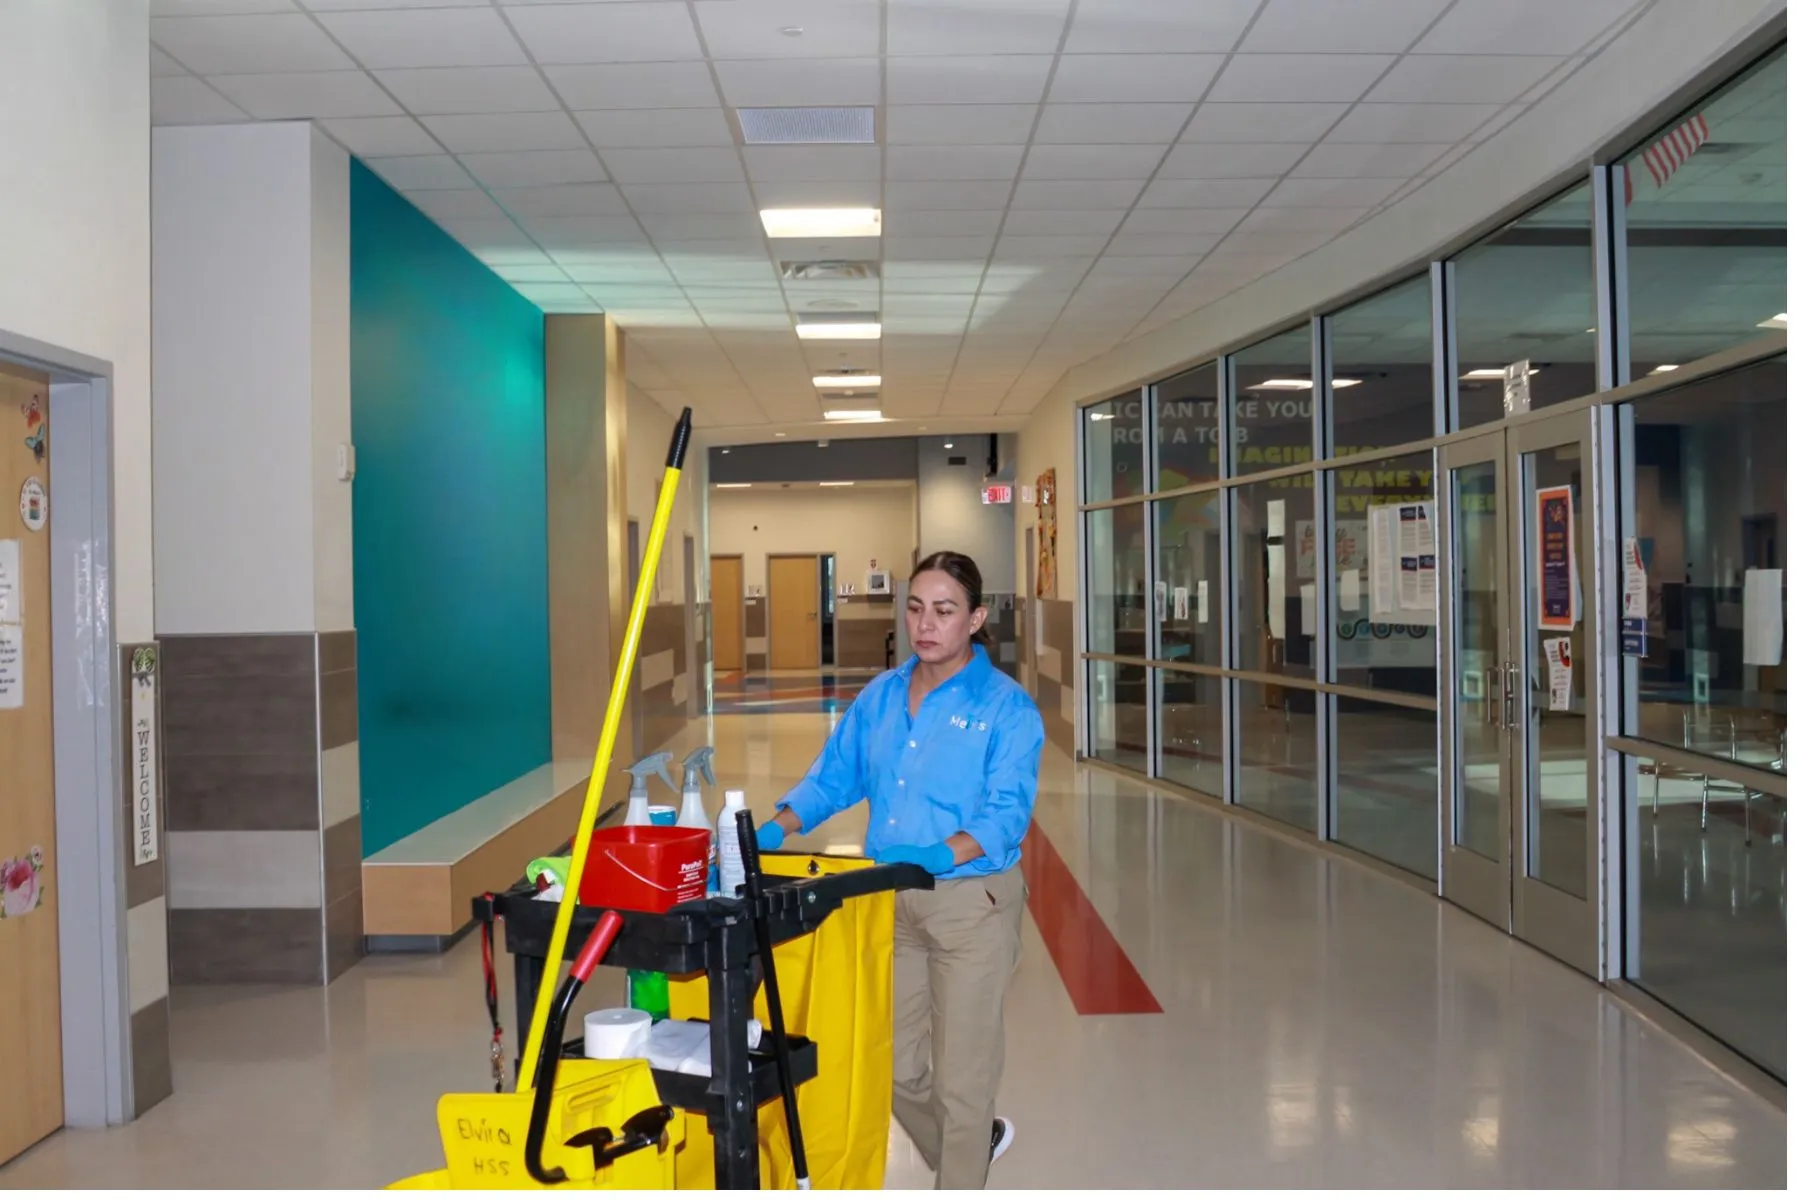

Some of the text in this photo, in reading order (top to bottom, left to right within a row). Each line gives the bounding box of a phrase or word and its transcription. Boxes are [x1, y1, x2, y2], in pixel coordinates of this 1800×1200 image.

[1266, 401, 1314, 418] YOU
[1172, 427, 1188, 444] A
[1236, 427, 1249, 443] B
[1339, 470, 1412, 488] TAKE
[137, 730, 151, 846] WELCOME
[457, 1118, 512, 1146] Elvira
[473, 1157, 510, 1176] HSS
